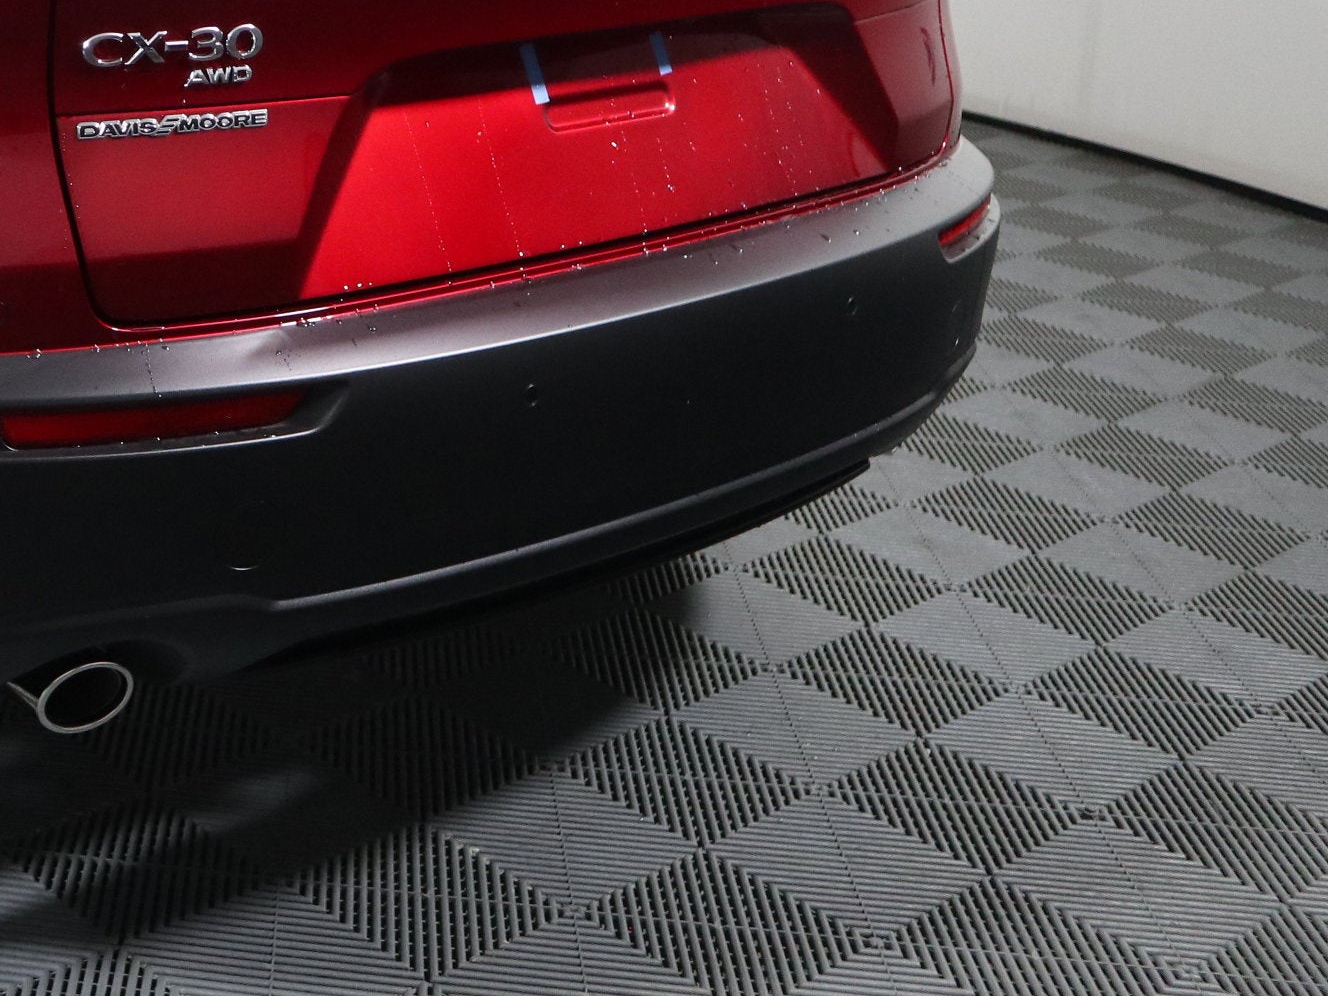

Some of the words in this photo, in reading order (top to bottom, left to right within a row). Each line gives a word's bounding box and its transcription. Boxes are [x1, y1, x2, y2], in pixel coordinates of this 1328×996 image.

[80, 22, 265, 68] CX-30
[183, 64, 253, 88] AWD
[77, 117, 160, 140] DAVIS
[177, 108, 269, 134] MOORE
